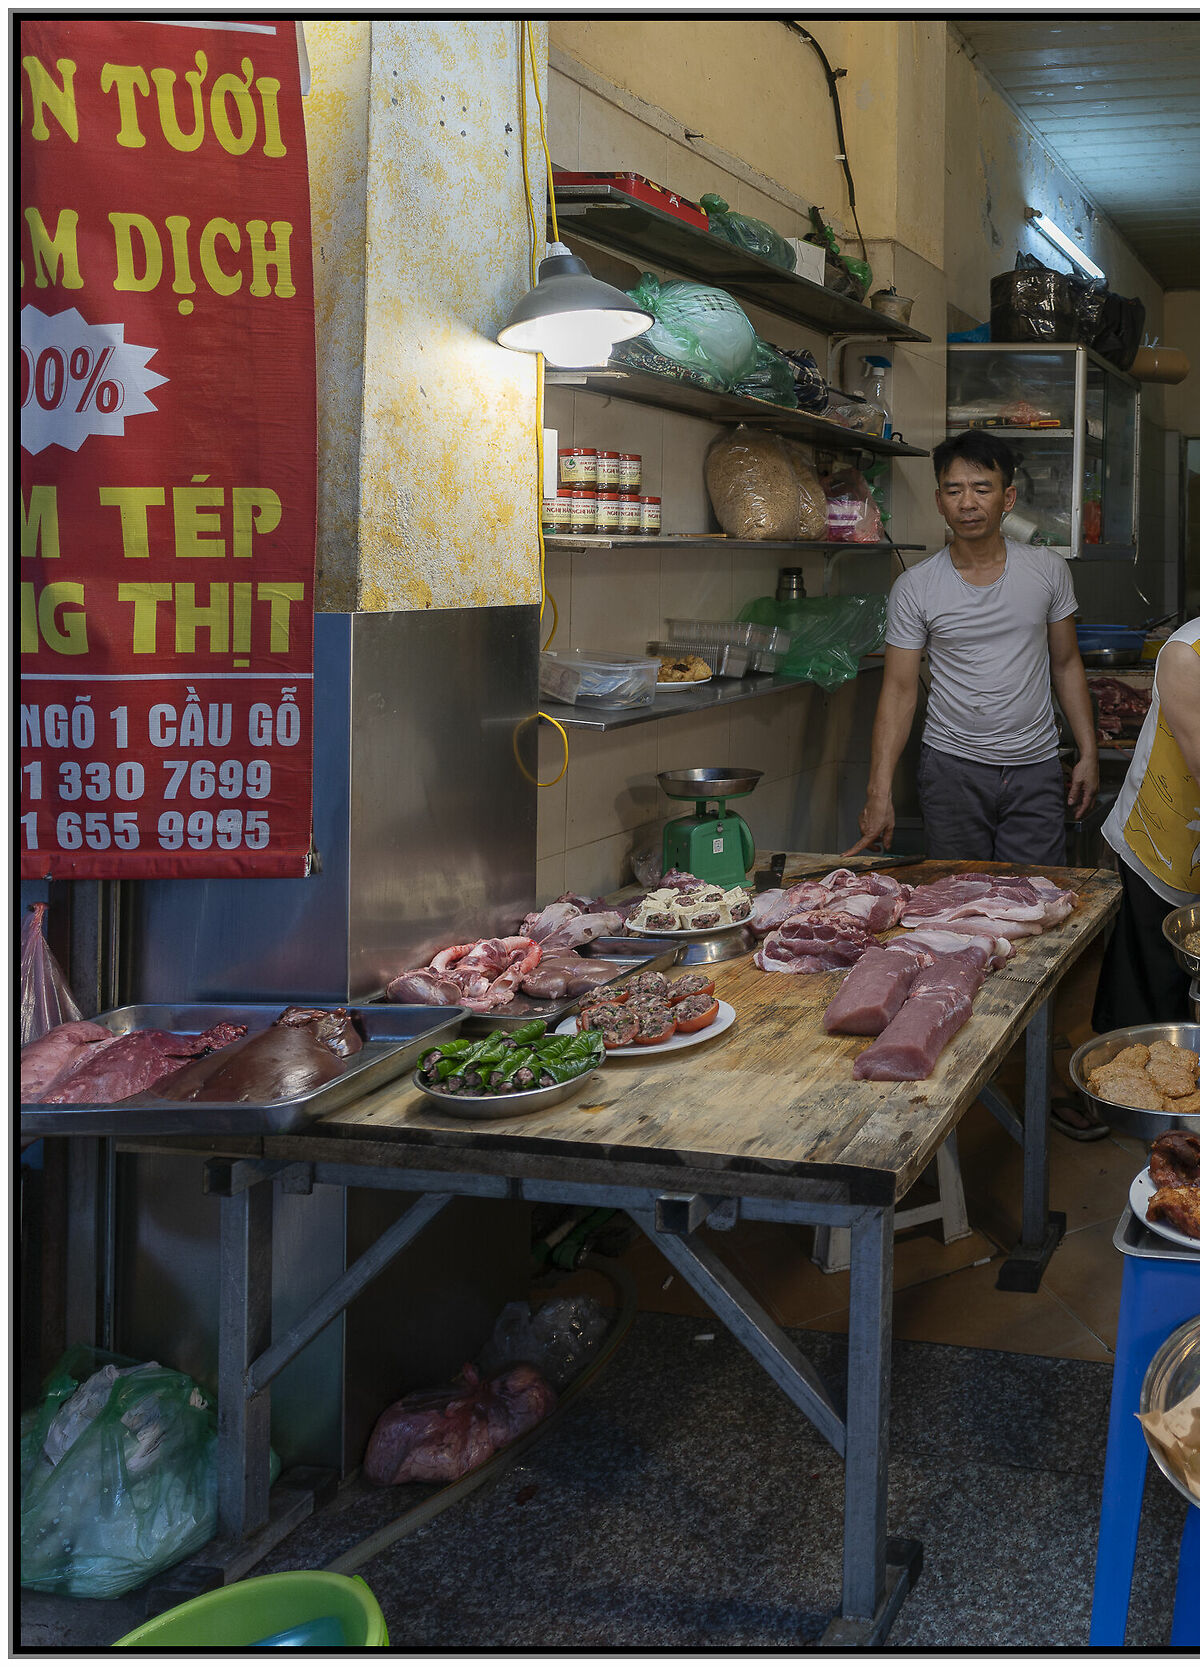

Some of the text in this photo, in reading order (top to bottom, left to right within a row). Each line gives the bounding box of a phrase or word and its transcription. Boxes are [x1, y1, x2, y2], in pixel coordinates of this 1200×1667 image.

[21, 50, 287, 157] N TƯƠI
[21, 207, 296, 315] M DỊCH
[99, 474, 282, 558] TÉP
[118, 582, 305, 667] THỊT
[21, 686, 301, 749] NGÕ 1 CẦU GỖ
[21, 759, 272, 802] 1 330 7699
[56, 811, 141, 851] 655
[158, 808, 270, 851] 9995
